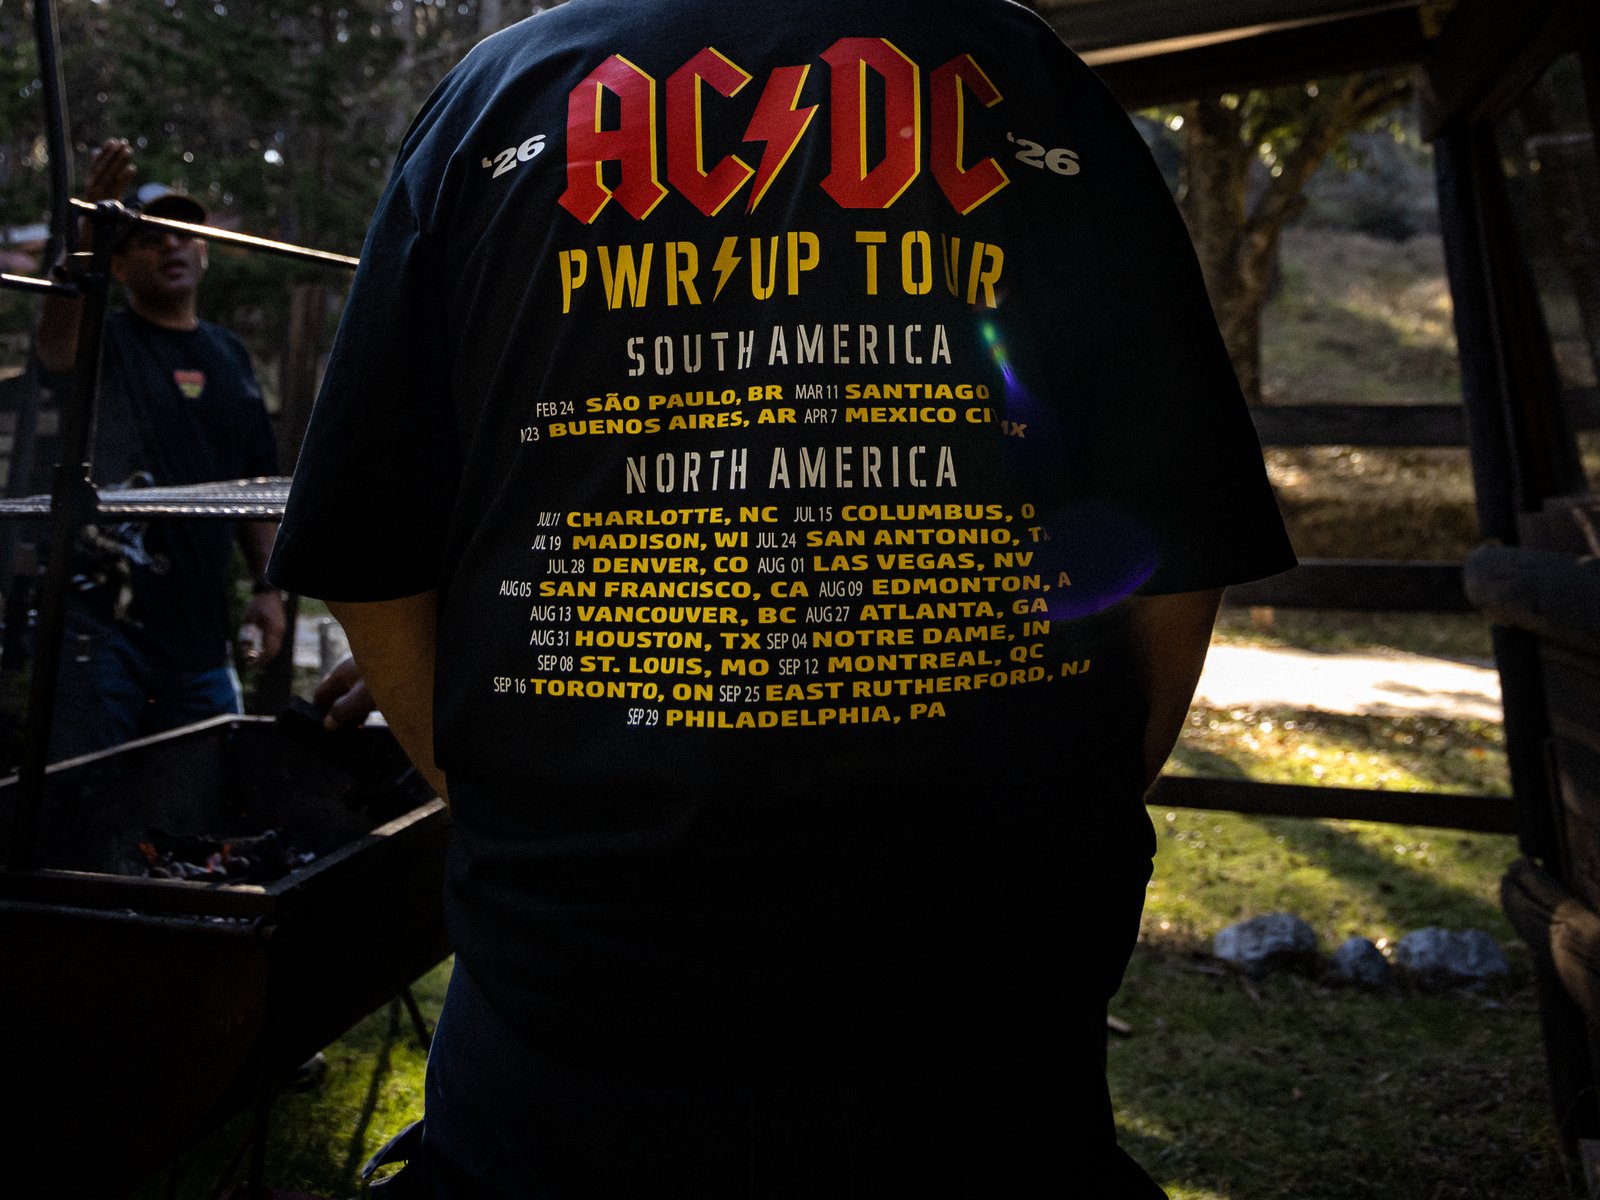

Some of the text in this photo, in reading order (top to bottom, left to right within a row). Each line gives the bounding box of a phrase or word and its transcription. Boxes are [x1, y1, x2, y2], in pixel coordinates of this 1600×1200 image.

[856, 231, 1004, 308] TOUR
[627, 324, 951, 376] SOUTH AMERICA
[537, 384, 989, 417] FEB 24 SÃO PAULO, BR MAR 11 SANTIAGO
[549, 418, 660, 437] BUENOS
[669, 411, 749, 430] AIRES,
[758, 408, 796, 424] AR
[805, 409, 827, 423] APR
[831, 409, 837, 423] 7
[846, 407, 956, 423] MEXICO
[964, 407, 998, 424] CI
[627, 446, 957, 494] NORTH AMERICA
[537, 512, 551, 526] JUL
[567, 508, 731, 527] CHARLOTTE,
[740, 506, 777, 522] NC
[794, 507, 815, 522] JUL
[819, 507, 832, 521] 15
[842, 504, 1012, 522] COLUMBUS,
[532, 535, 546, 550] JUL
[550, 536, 561, 550] 19
[573, 533, 707, 551] MADISON,
[715, 532, 748, 547] WI
[756, 533, 778, 548] JUL
[782, 533, 796, 548] 24
[807, 530, 865, 547] SAN
[874, 529, 1019, 546] ANTONIO,
[547, 552, 1033, 575] JUL 28 DENVER, CO AUG 01 LAS VEGAS, NV
[499, 580, 518, 596] AUG
[520, 582, 531, 597] 05
[540, 581, 596, 597] SAN
[605, 582, 760, 600] FRANCISCO,
[771, 581, 808, 598] CA
[819, 581, 845, 597] AUG
[848, 581, 862, 596] 09
[873, 575, 1050, 595] EDMONTON,
[530, 598, 1049, 626] AUG 13 VANCOUVER, BC AUG 27 ATLANTA, GA
[530, 620, 1050, 651] AUG 31 HOUSTON, TX SEP 04 NOTRE DAME, IN
[538, 643, 1043, 678] SEP 08 ST. LOUIS, MO SEP 12 MONTREAL, QC
[494, 659, 1090, 702] SEP 16 TORONTO, ON SEP 25 EAST RUTHERFORD, NJ
[627, 702, 945, 728] SEP 29 PHILADELPHIA, PA
